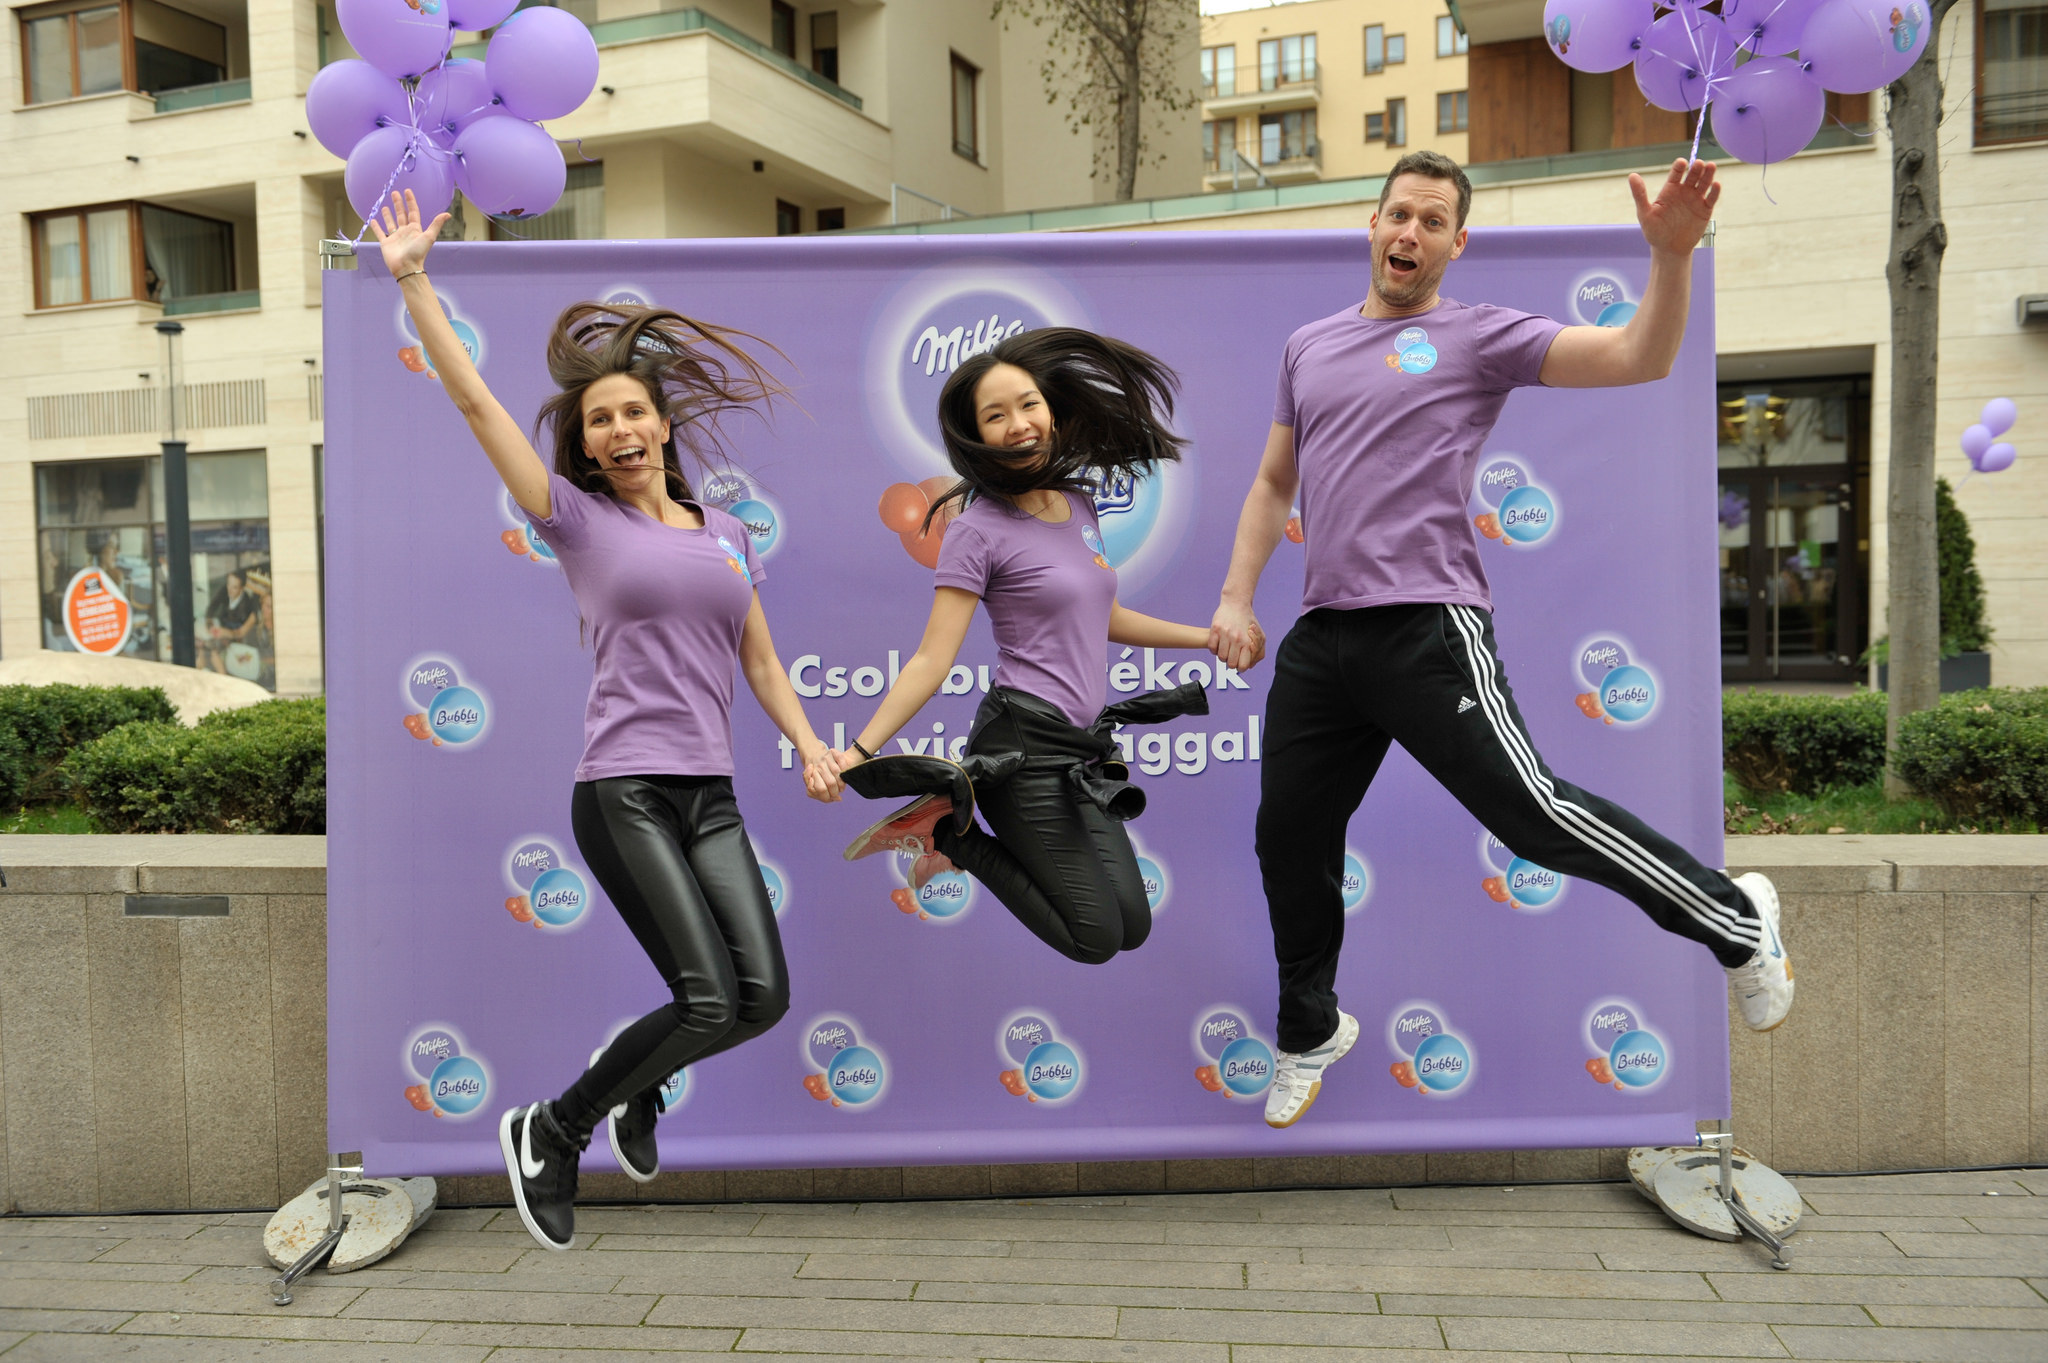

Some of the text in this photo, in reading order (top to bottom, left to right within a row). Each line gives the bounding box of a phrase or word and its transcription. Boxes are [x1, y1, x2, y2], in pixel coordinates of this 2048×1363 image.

[1579, 283, 1614, 301] Milka
[1403, 353, 1431, 365] Bubbly
[1483, 467, 1518, 485] Milka
[1506, 507, 1547, 525] Bubbly
[1584, 646, 1618, 665] Milka
[412, 667, 449, 685] Milka
[1607, 687, 1649, 704] Bubbly
[1457, 700, 1477, 714] adidas
[436, 708, 478, 726] Bubbly
[514, 849, 550, 868] Milka
[1514, 871, 1555, 888] Bubbly
[537, 890, 579, 908] Bubbly
[923, 882, 963, 900] Bubbly
[1203, 1018, 1238, 1037] Milka
[1398, 1014, 1433, 1033] Milka
[1593, 1011, 1628, 1030] Milka
[812, 1027, 847, 1045] Milka
[1008, 1022, 1043, 1041] Milka
[414, 1037, 450, 1056] Milka
[1227, 1059, 1267, 1077] Bubbly
[1421, 1055, 1463, 1074] Bubbly
[1617, 1052, 1658, 1070] Bubbly
[835, 1068, 876, 1086] Bubbly
[1031, 1064, 1072, 1082] Bubbly
[437, 1078, 479, 1096] Bubbly
